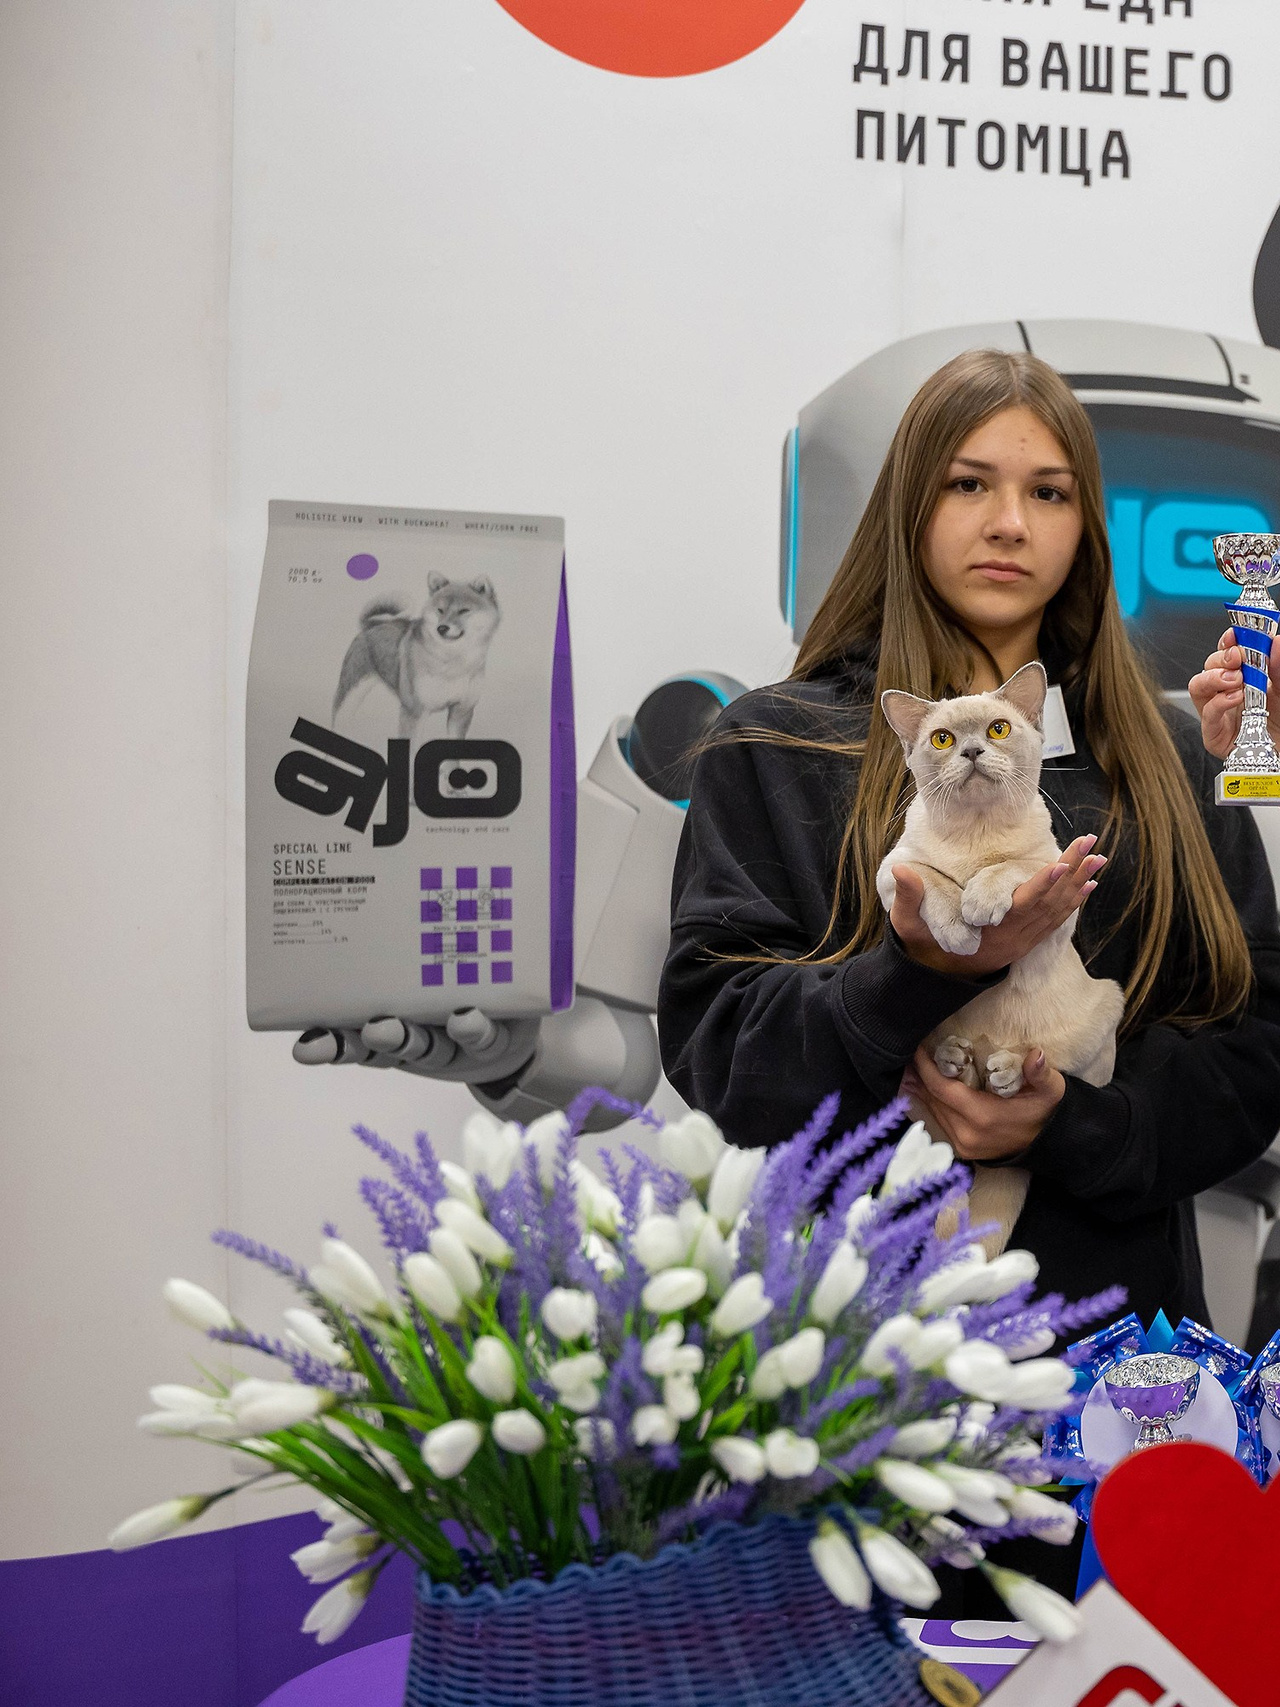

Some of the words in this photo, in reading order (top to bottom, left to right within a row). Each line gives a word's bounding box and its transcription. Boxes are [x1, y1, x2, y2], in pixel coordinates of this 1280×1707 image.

[853, 23, 970, 86] ДЛЯ
[1002, 37, 1232, 101] ВАШЕГО
[855, 109, 1131, 187] ПИТОМЦА
[273, 843, 319, 854] SPECIAL
[326, 842, 352, 853] LINE
[273, 858, 326, 875] SENSE
